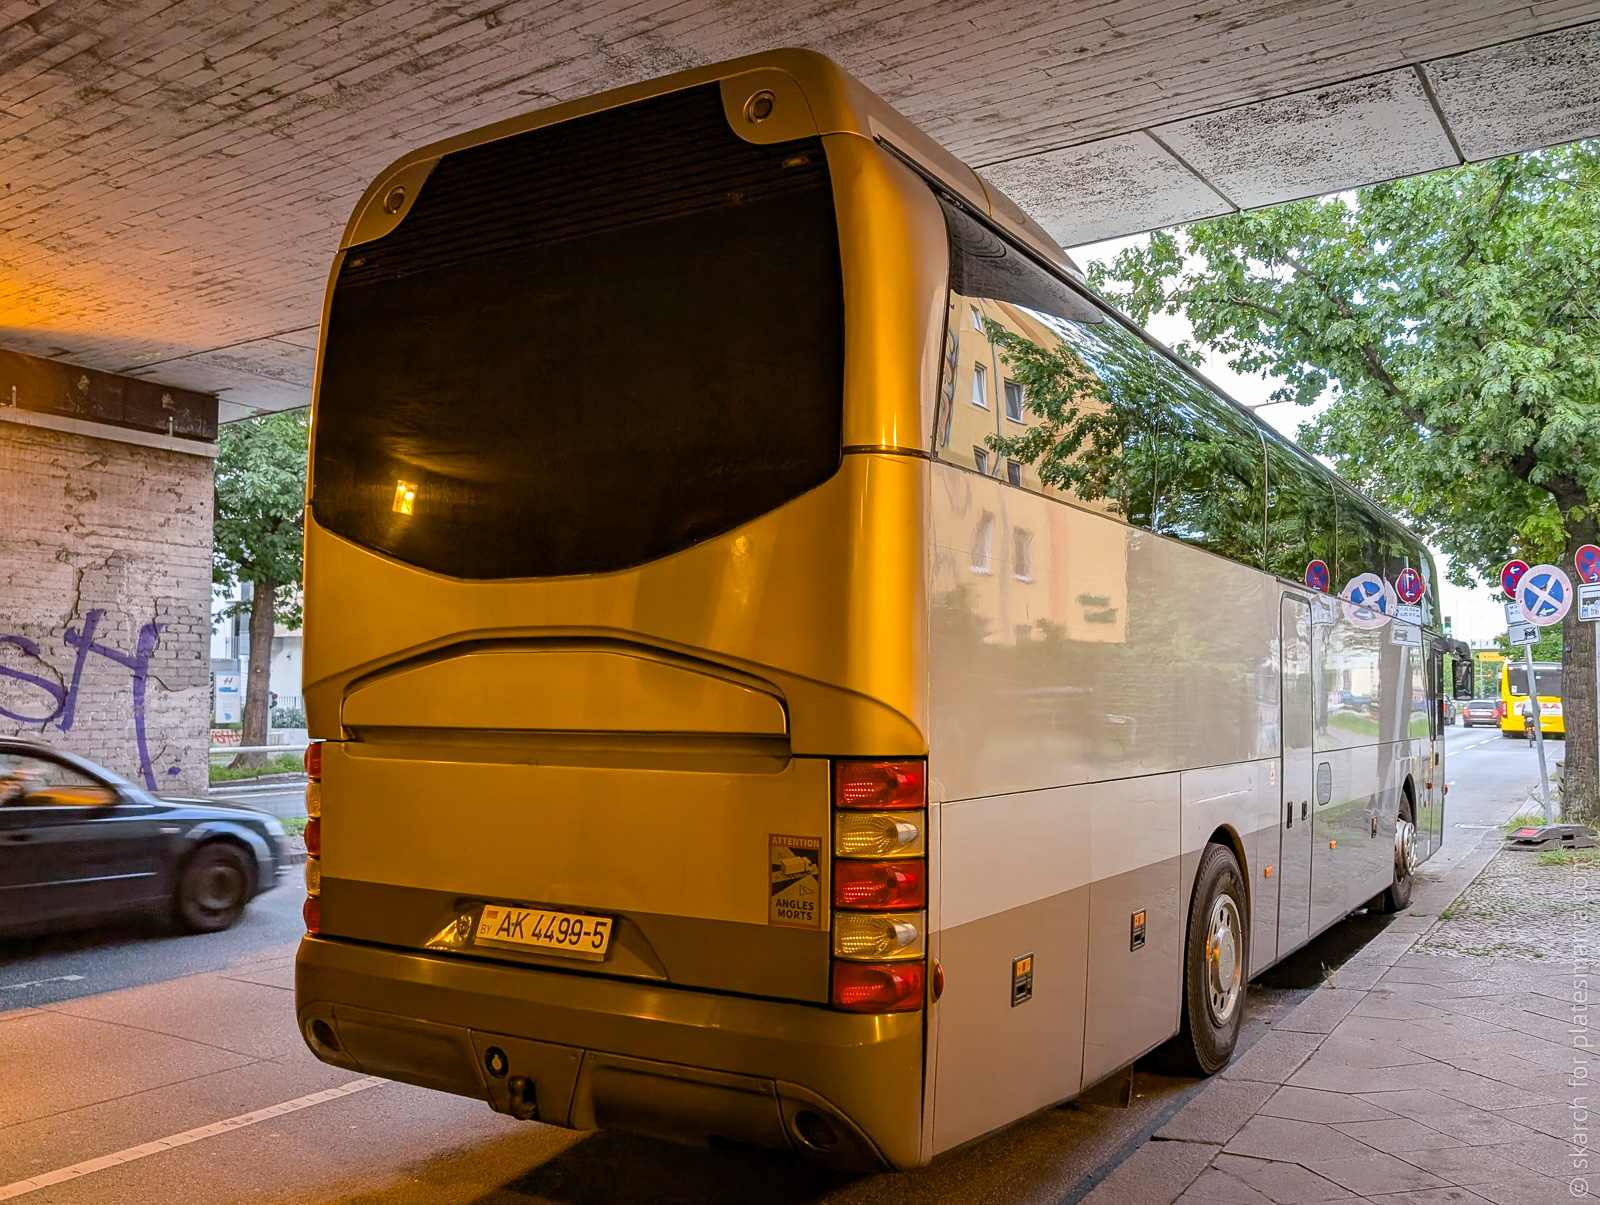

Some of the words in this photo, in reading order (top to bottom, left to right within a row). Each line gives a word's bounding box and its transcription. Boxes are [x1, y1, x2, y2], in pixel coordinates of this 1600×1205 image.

[772, 836, 820, 848] ATTENTION
[776, 898, 814, 911] ANGLES
[777, 908, 813, 921] MORTS
[480, 923, 492, 935] BY
[495, 910, 530, 939] AK
[531, 914, 608, 949] 4499-5
